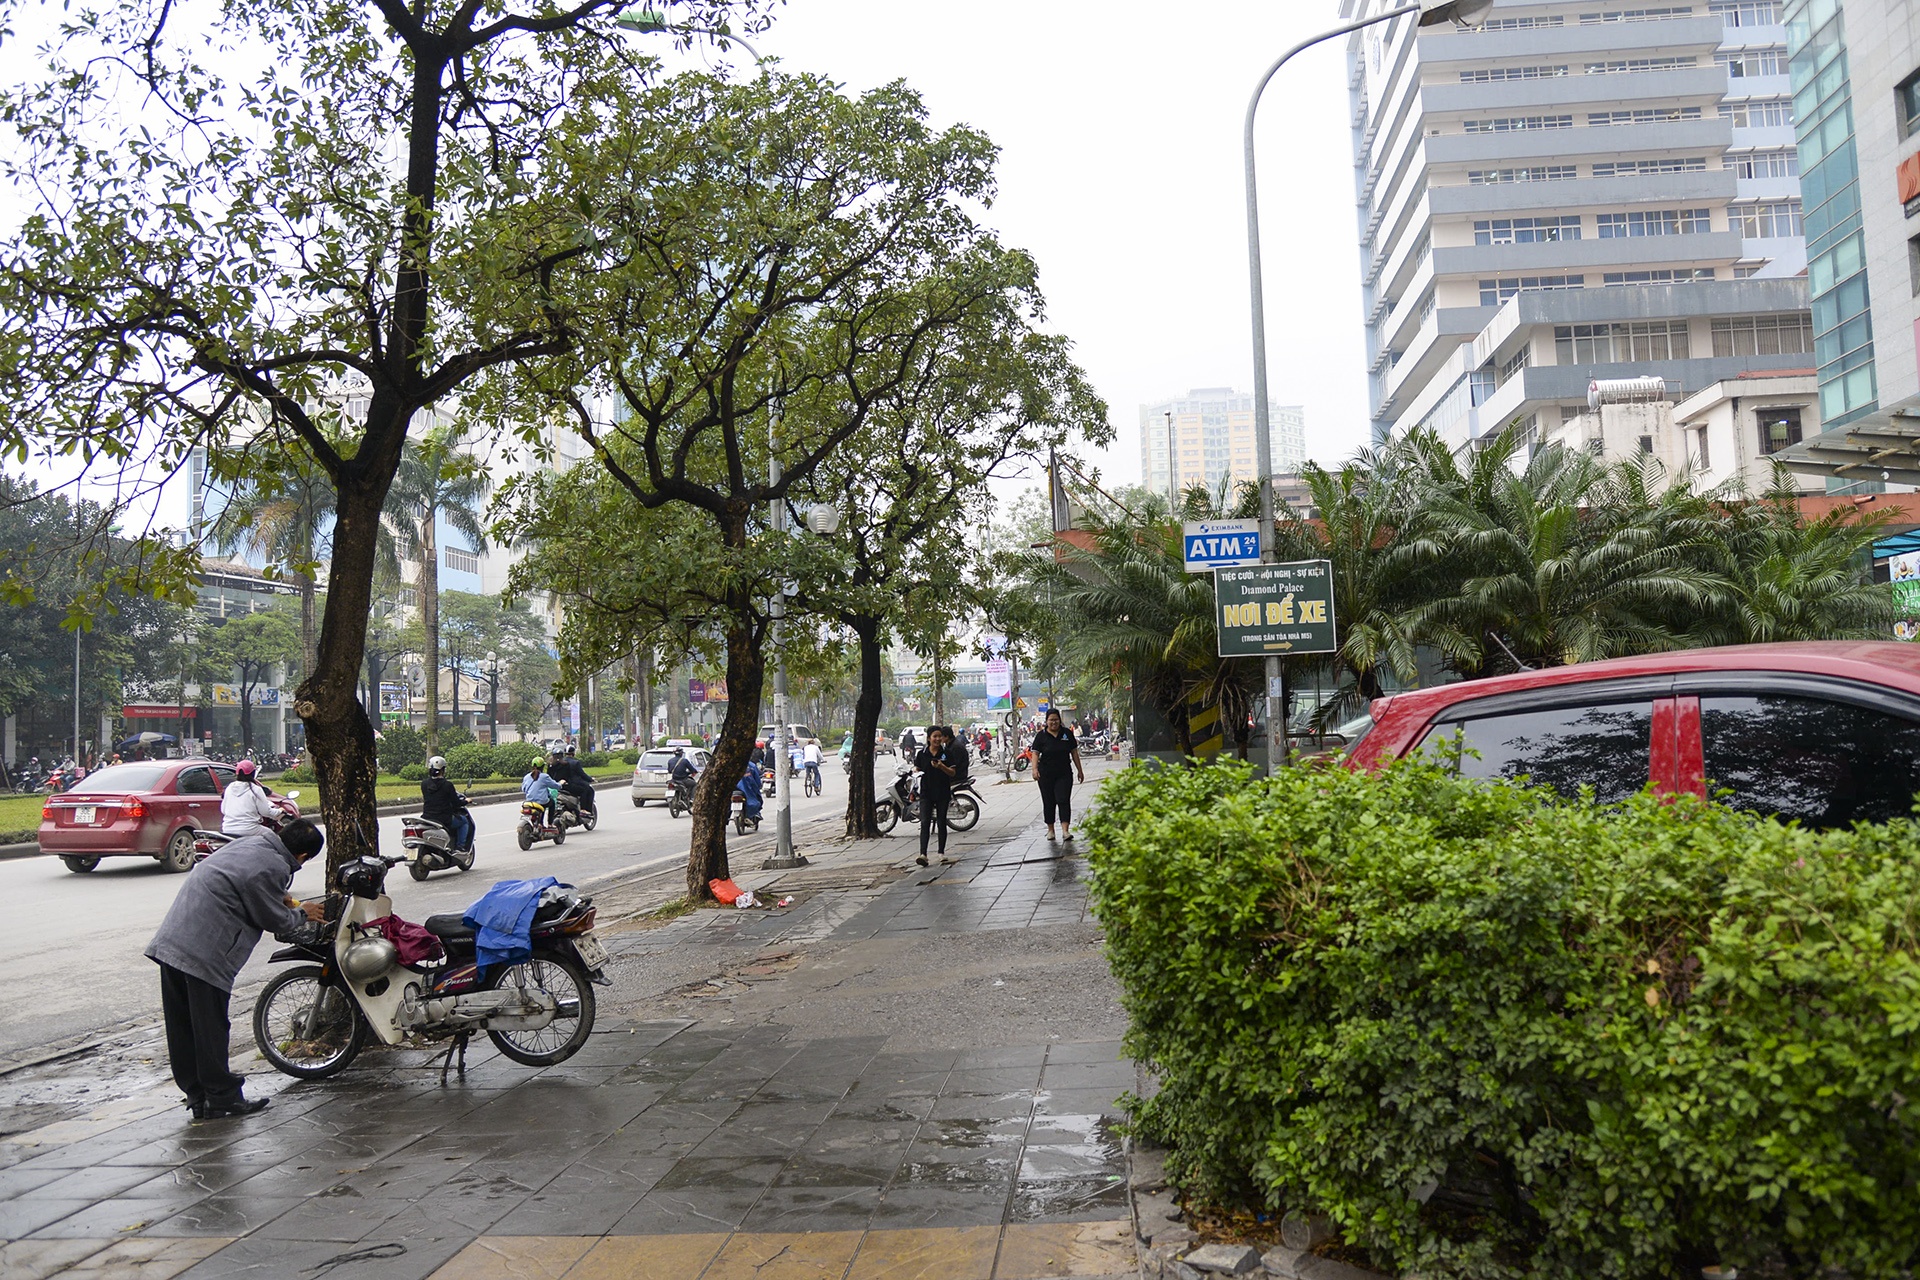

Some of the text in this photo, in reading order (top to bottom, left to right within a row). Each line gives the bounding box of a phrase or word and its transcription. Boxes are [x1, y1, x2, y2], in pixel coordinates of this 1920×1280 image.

[1189, 536, 1256, 558] ATM 24
[1247, 547, 1254, 555] 7
[1241, 583, 1304, 595] Diamond Palace
[1223, 593, 1327, 628] NƠI ĐỂ XE
